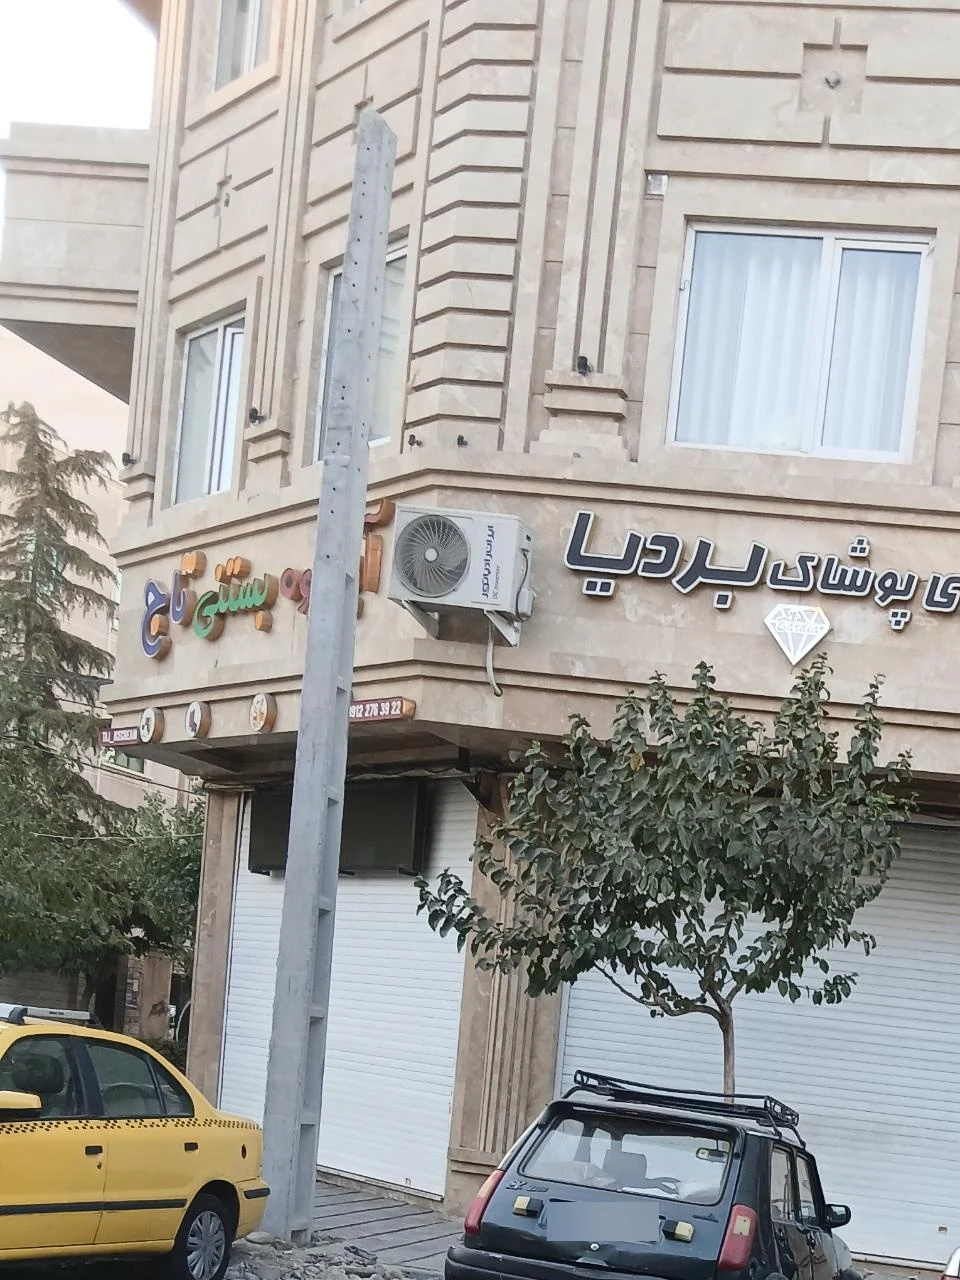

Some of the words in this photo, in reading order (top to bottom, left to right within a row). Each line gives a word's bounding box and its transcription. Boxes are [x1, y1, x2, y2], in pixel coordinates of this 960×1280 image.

[142, 550, 206, 659] تاج
[191, 556, 278, 640] بستنی
[564, 510, 768, 609] بردیا
[766, 535, 918, 631] پوشاک
[390, 700, 401, 715] 22
